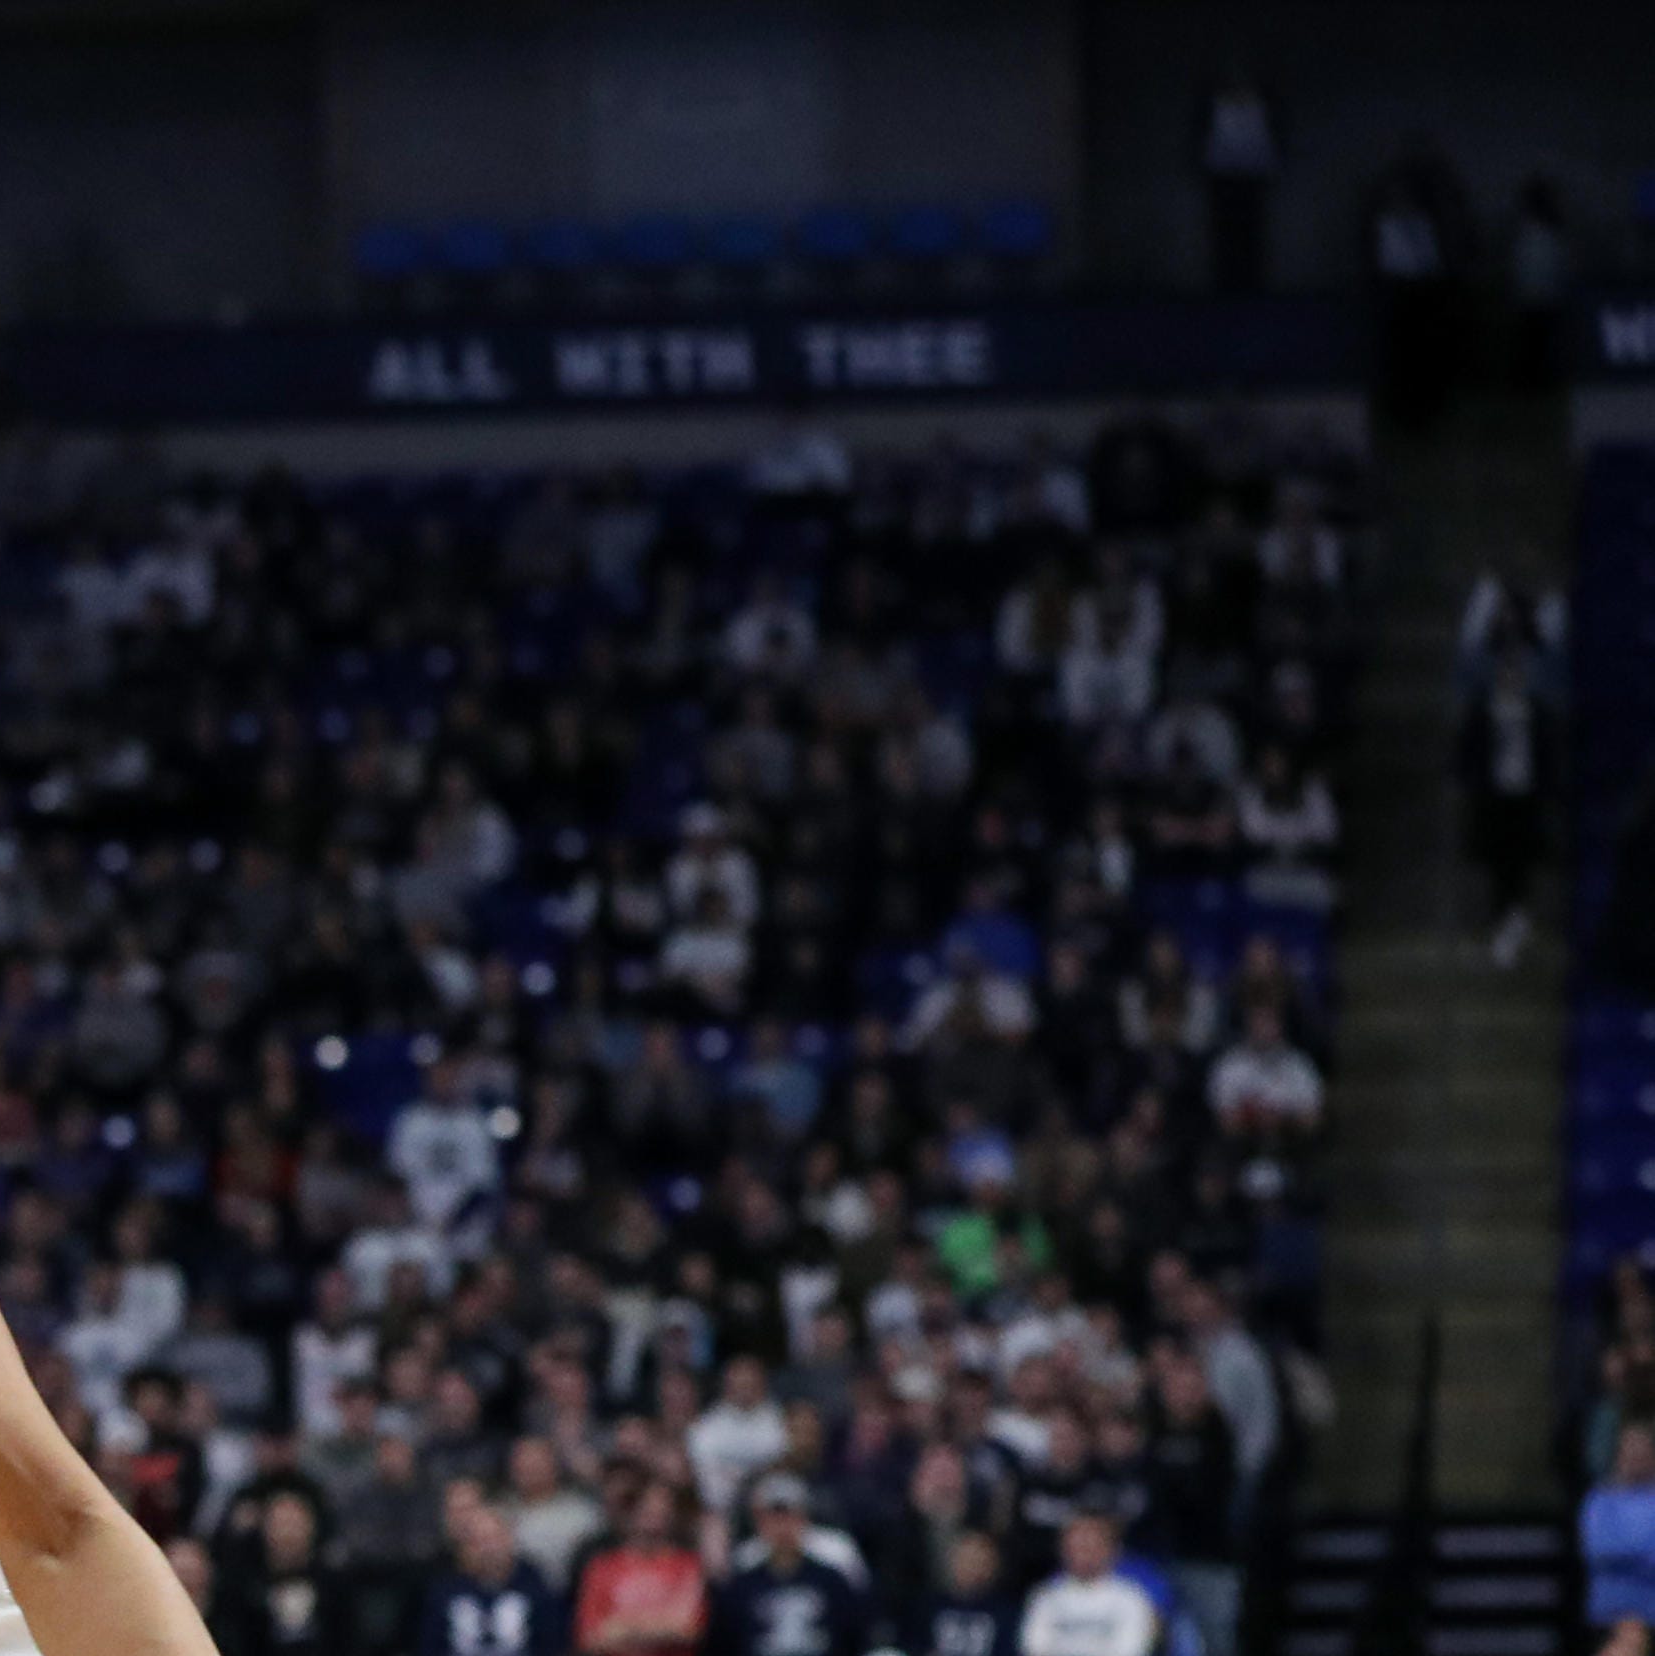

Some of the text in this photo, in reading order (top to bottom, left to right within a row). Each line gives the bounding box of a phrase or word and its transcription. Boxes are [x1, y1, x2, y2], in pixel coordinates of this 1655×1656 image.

[369, 318, 991, 401] ALL WITH THEE
